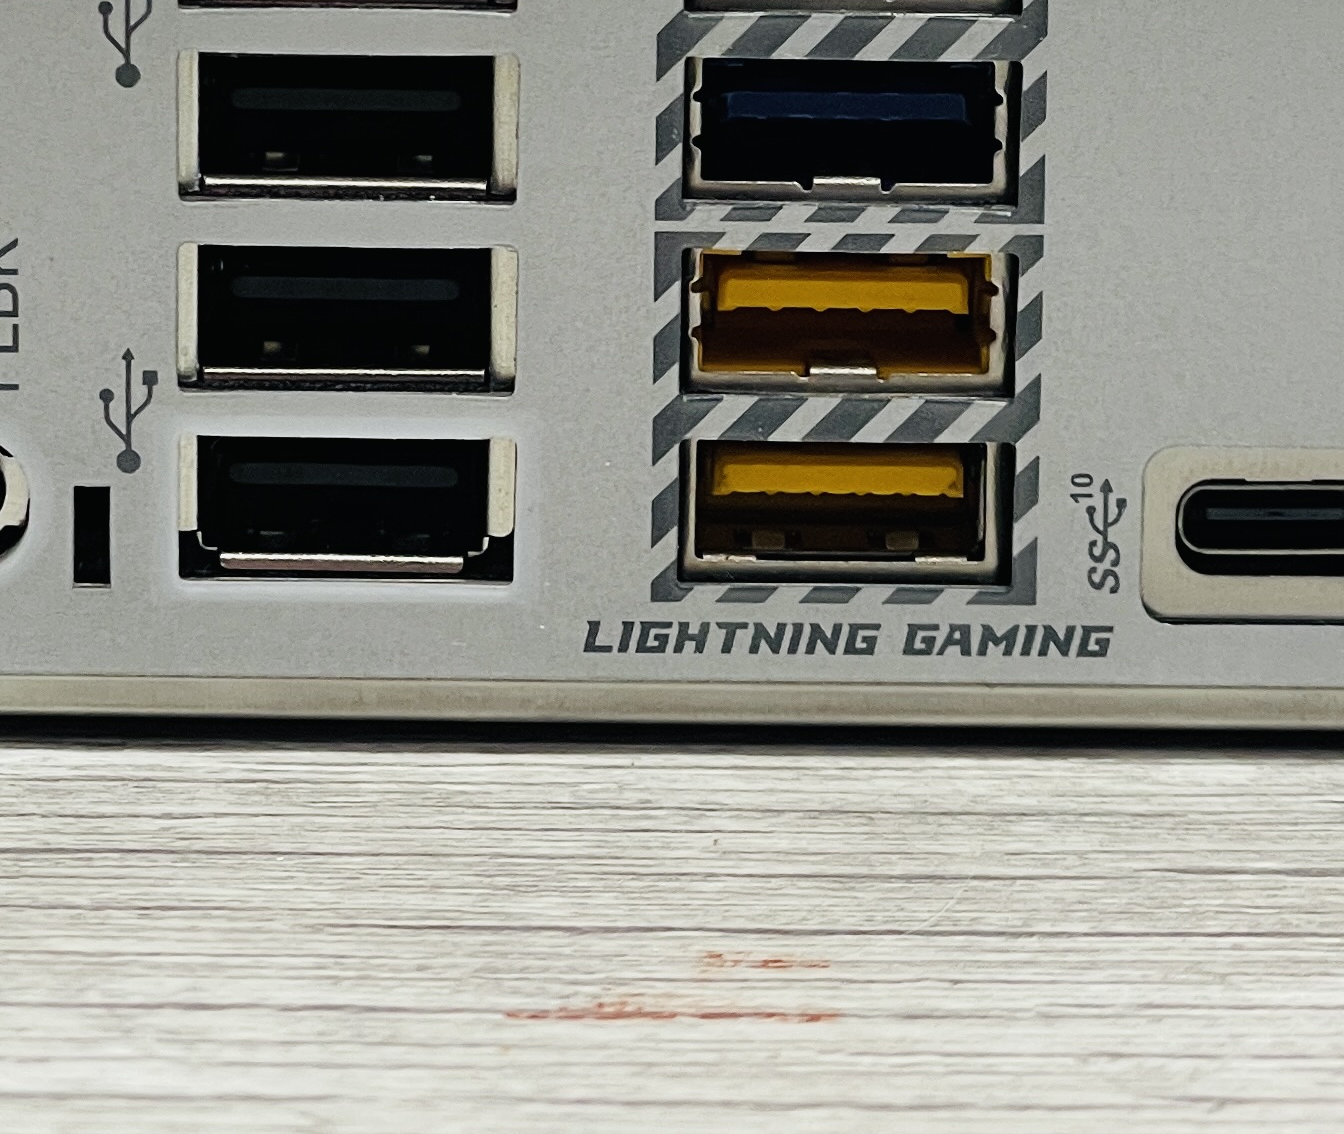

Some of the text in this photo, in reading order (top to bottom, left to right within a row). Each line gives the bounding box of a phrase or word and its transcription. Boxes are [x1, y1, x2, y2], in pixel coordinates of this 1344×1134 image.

[1069, 473, 1093, 503] 10
[582, 619, 1115, 659] LIGHTNING GAMING
